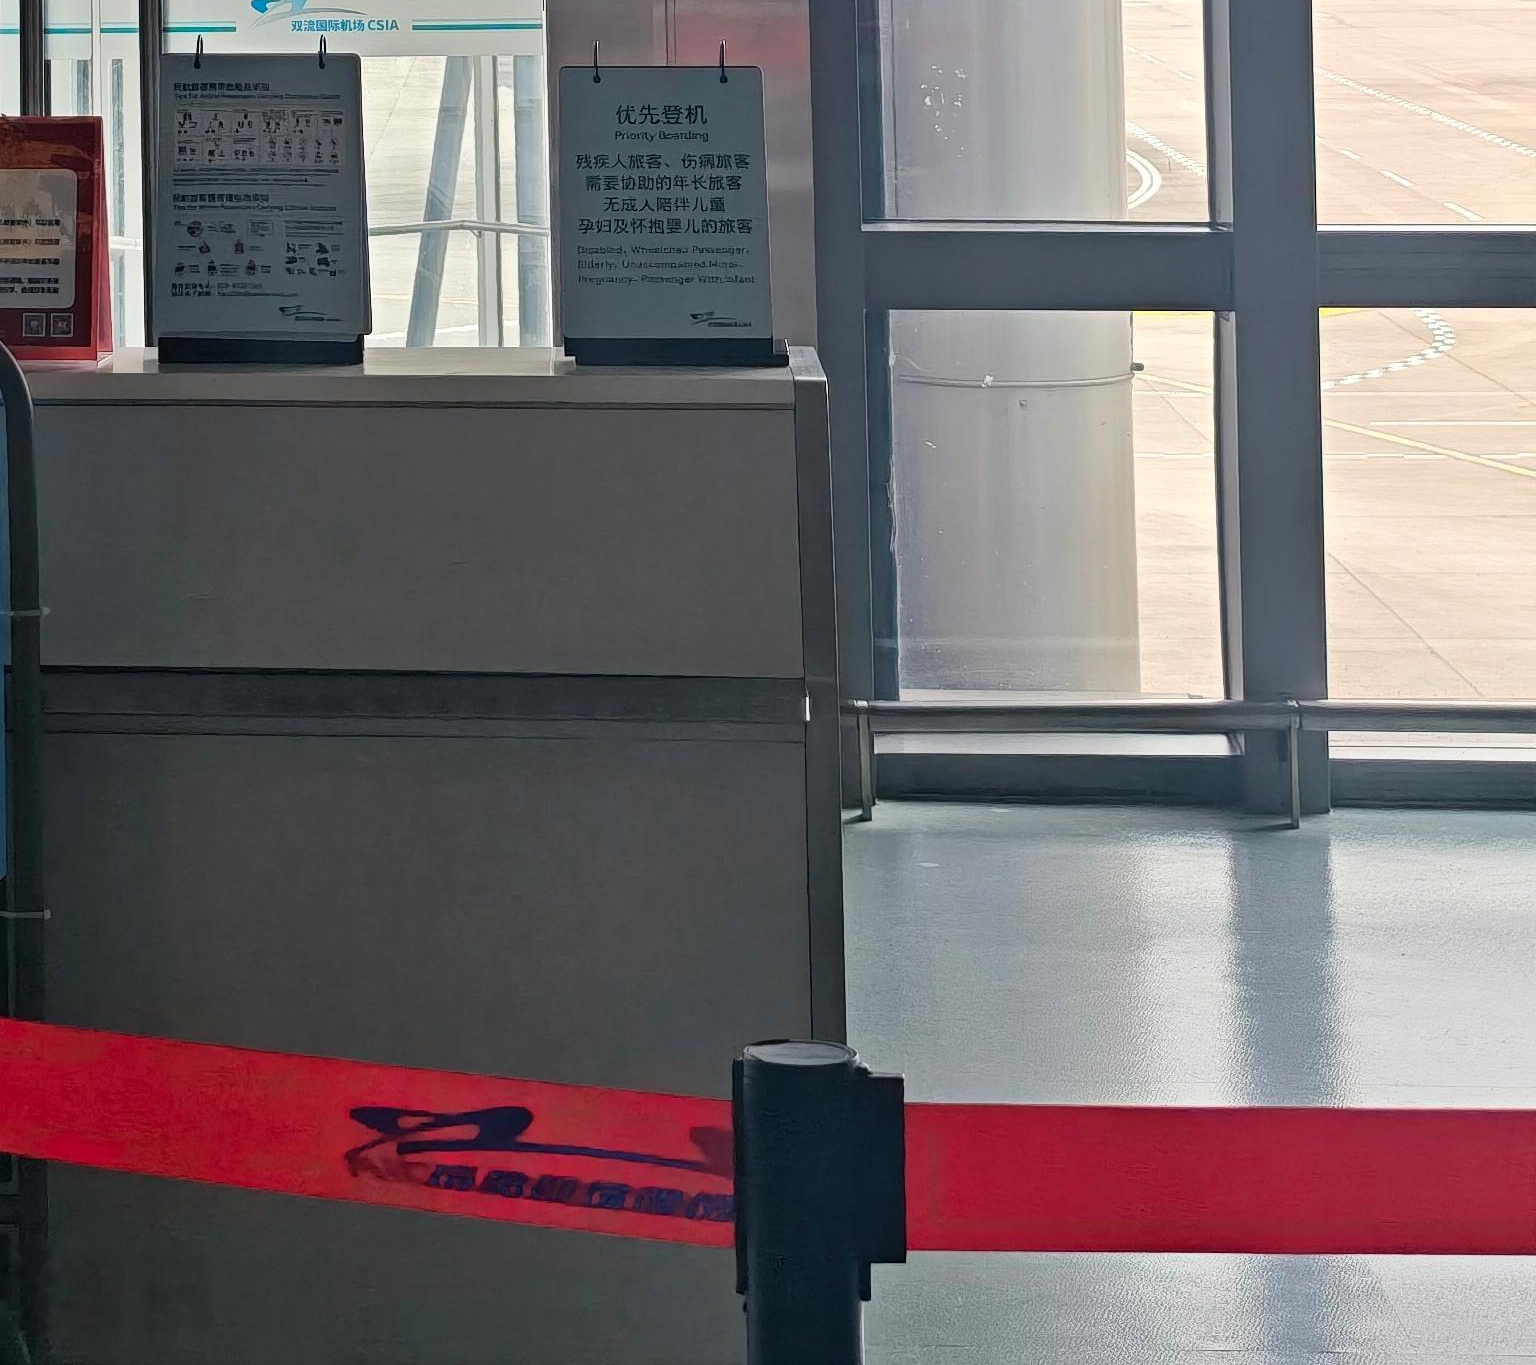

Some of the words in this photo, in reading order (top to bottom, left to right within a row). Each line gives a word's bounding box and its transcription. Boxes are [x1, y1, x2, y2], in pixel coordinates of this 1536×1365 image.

[291, 19, 365, 32] 双流国际机场
[367, 19, 400, 31] CSIA
[615, 103, 708, 126] 优先登机
[614, 130, 655, 143] Priority
[603, 195, 726, 213] 无成人陪伴儿童
